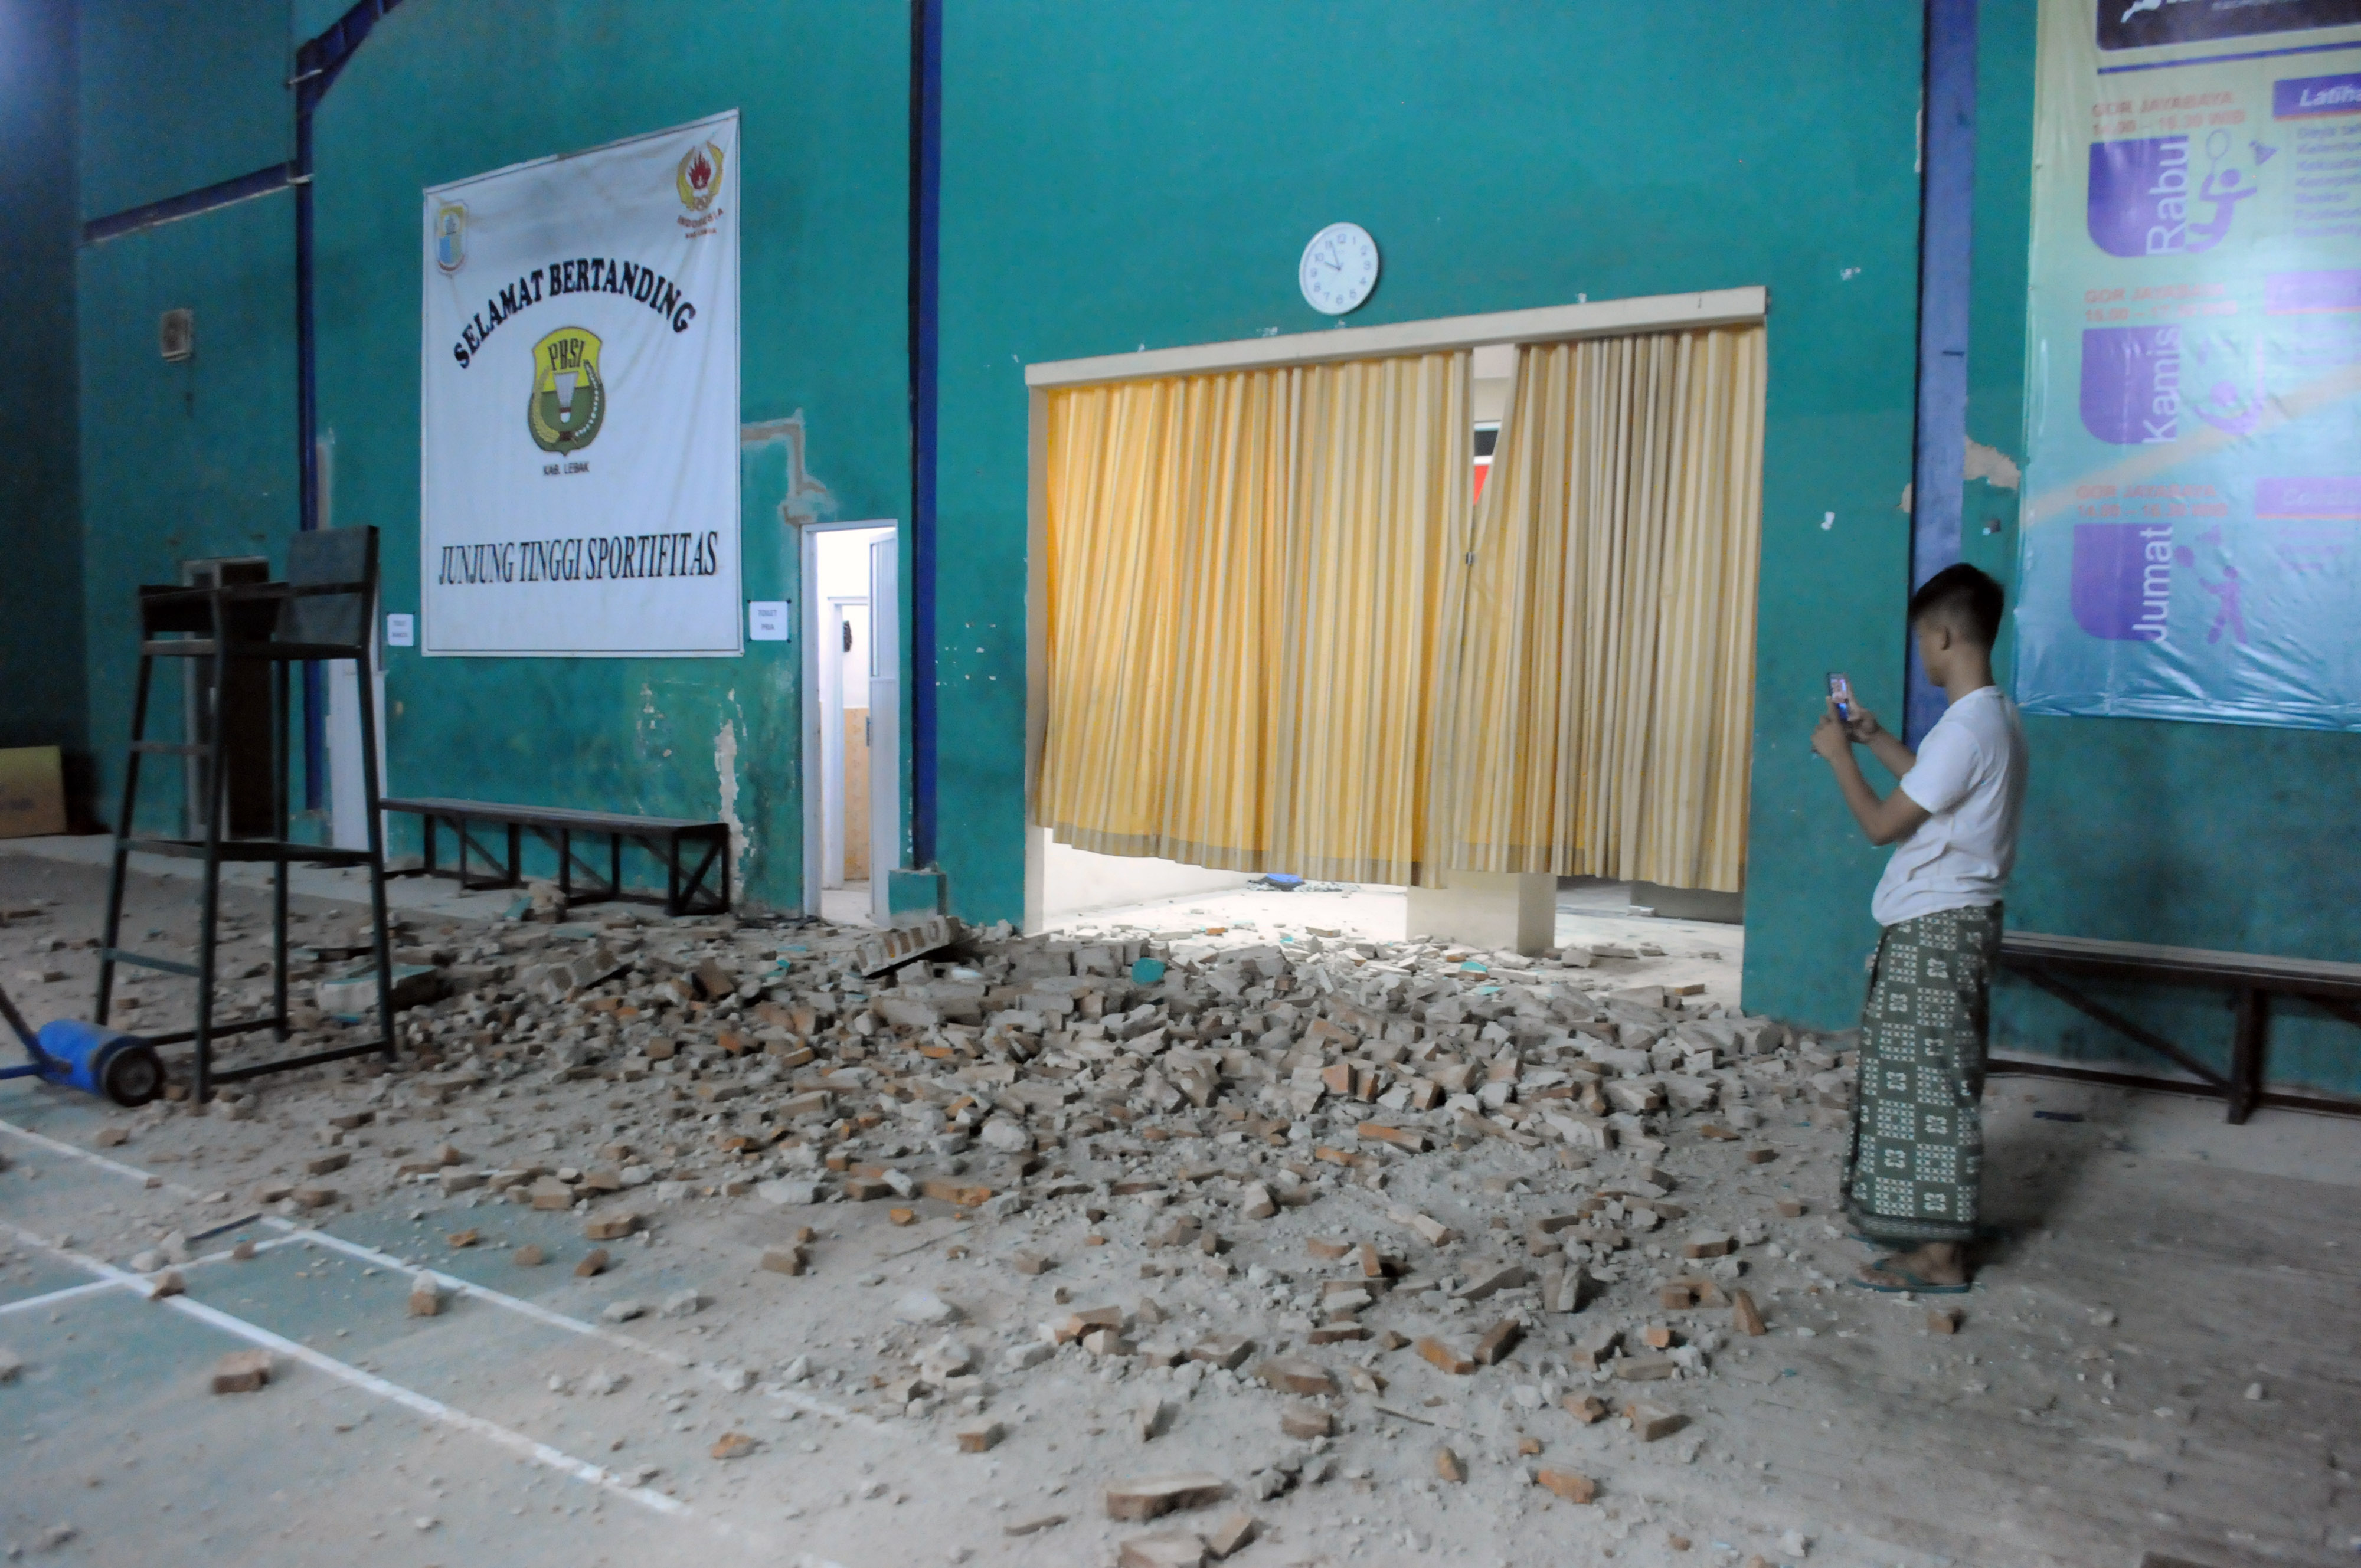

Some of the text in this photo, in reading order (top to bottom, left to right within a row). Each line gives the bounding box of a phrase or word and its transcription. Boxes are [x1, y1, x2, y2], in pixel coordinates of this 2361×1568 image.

[2146, 140, 2189, 256] Rabu
[453, 257, 696, 369] SELAMAT BERTANDING
[547, 337, 585, 372] PBSI
[2143, 326, 2182, 444] Kamis
[564, 461, 590, 474] LEBAK
[439, 531, 719, 585] JUNJUNG TINGGI SPORTIFITAS
[2132, 525, 2174, 644] Jumat
